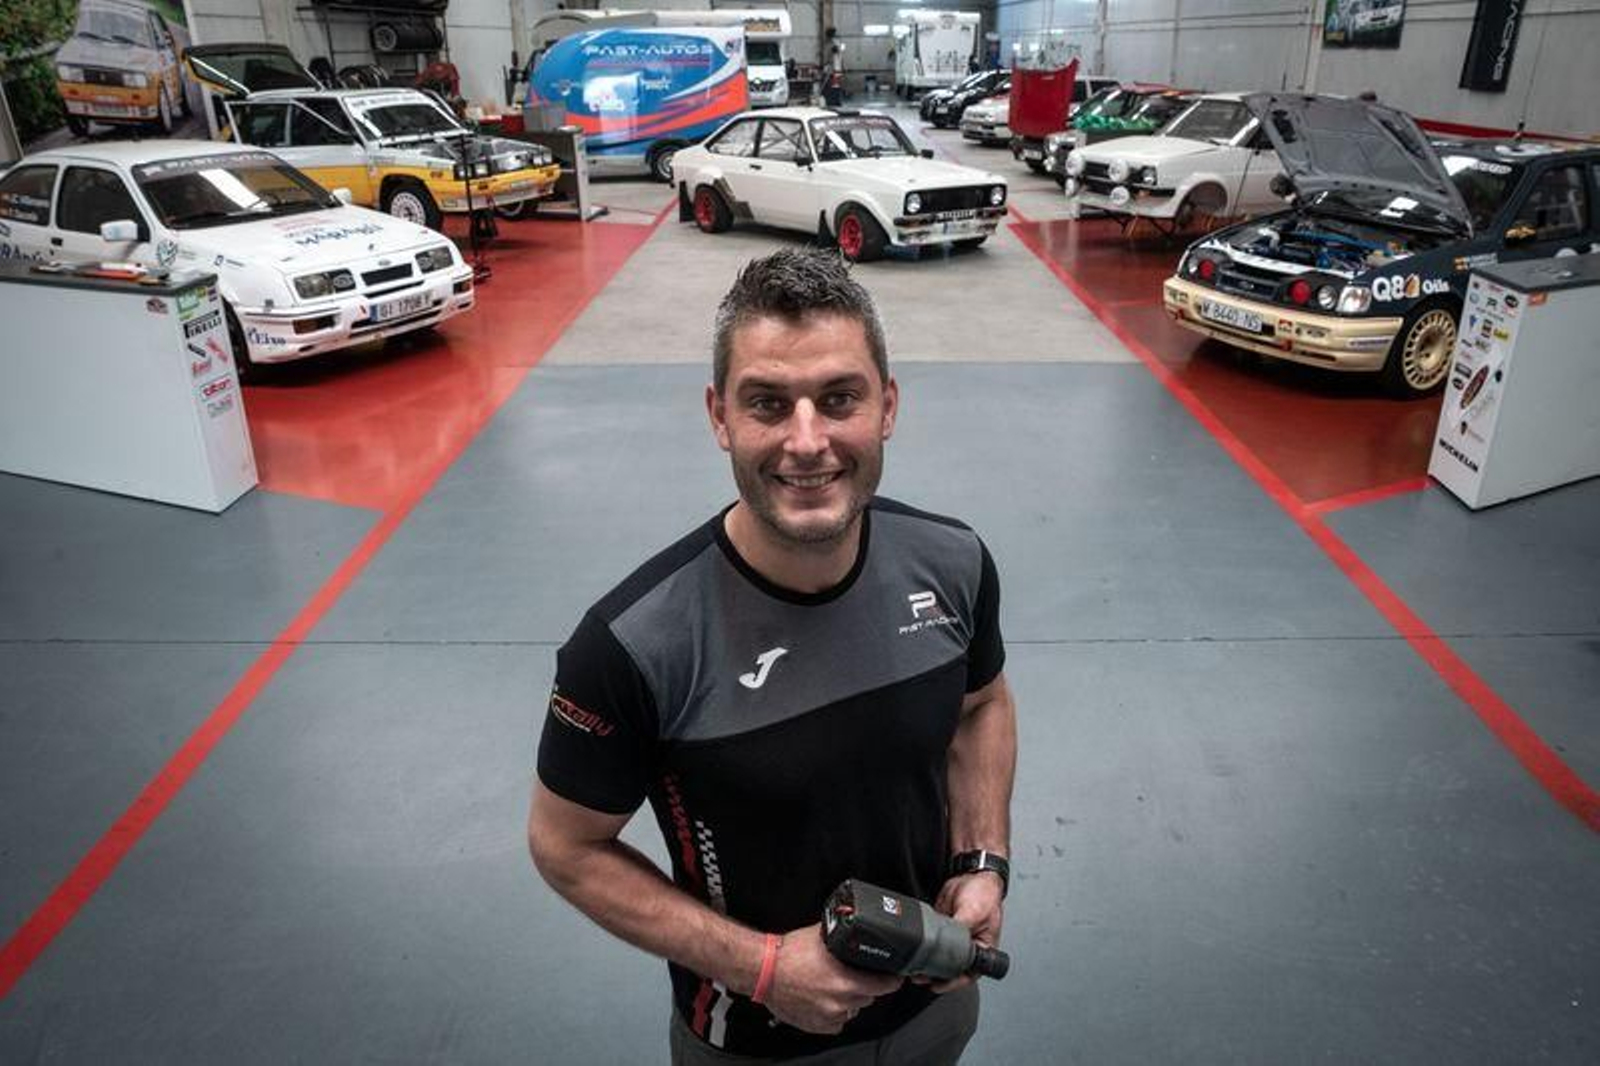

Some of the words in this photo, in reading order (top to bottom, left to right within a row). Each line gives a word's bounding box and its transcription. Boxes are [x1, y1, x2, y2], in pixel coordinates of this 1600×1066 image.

[1372, 275, 1404, 302] Q8
[1422, 279, 1449, 294] Oils
[184, 309, 222, 339] PIRELLI
[1439, 438, 1478, 473] MICHELIN
